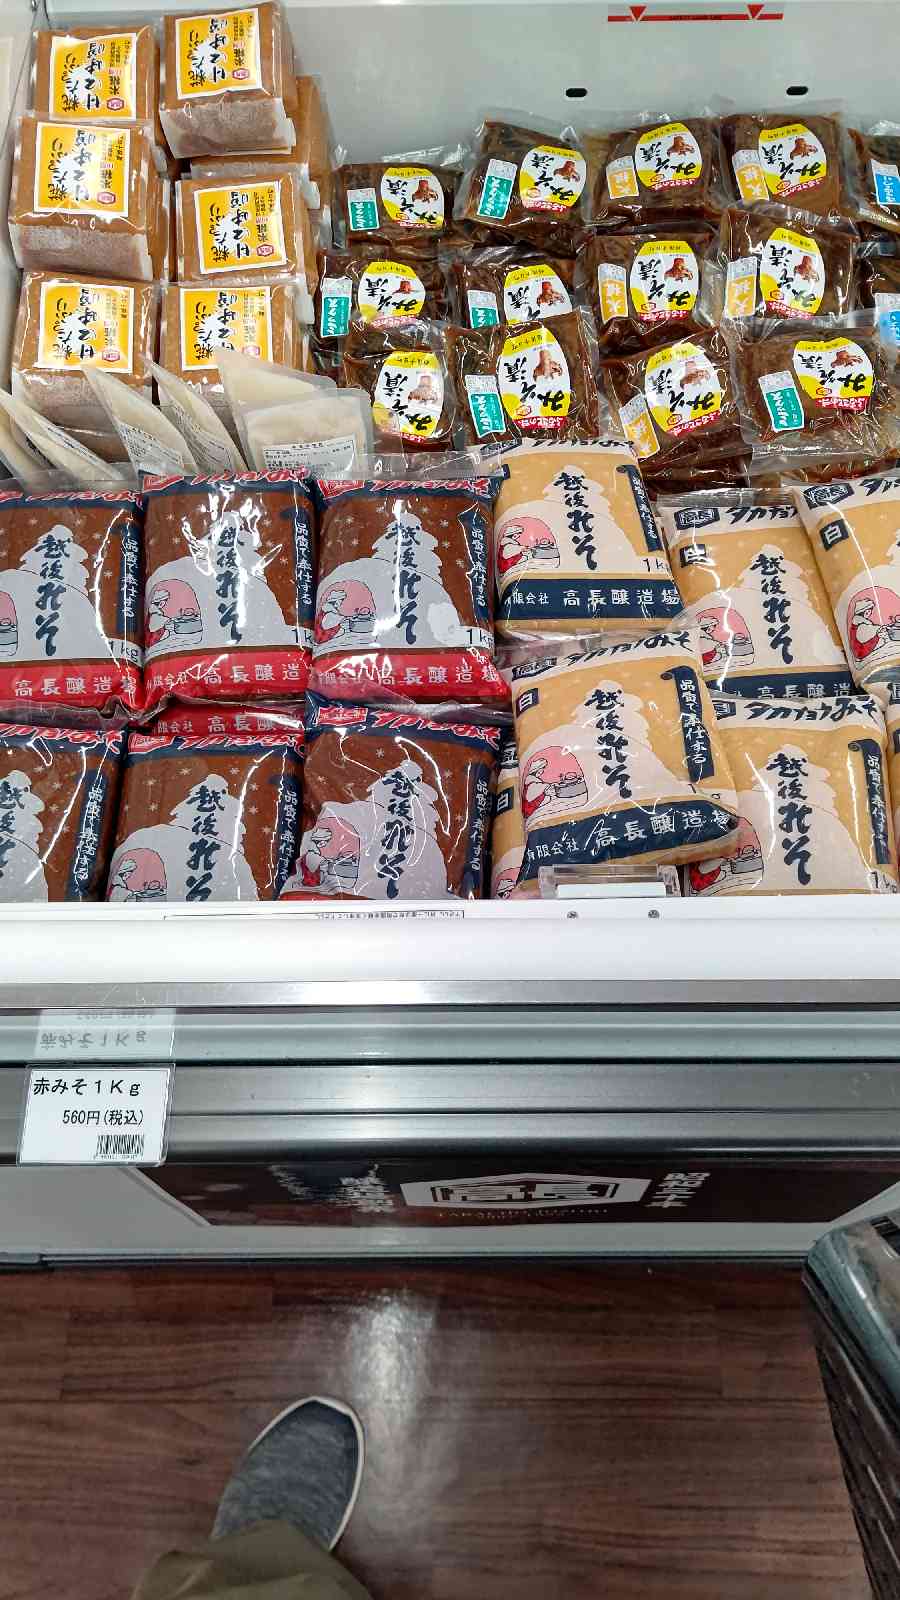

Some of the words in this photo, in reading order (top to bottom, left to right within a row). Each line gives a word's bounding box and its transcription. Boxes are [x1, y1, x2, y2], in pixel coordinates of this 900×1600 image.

[640, 142, 696, 175] みそ漬
[762, 144, 821, 179] みそ漬
[530, 153, 574, 201] みそ漬
[638, 259, 690, 306] みそ漬
[769, 244, 816, 307] みそ漬
[366, 279, 418, 311] みそ漬
[504, 357, 564, 411] みそ漬
[648, 368, 714, 412] みそ漬
[798, 354, 866, 391] みそ漬
[383, 371, 432, 430] みそ漬
[771, 393, 789, 427] ミックス
[824, 527, 843, 544] 白
[518, 693, 534, 712] 白
[679, 679, 708, 765] 品質で奉仕する
[33, 1077, 141, 1096] 赤みそ1Kg
[62, 1110, 144, 1126] 560円(税込)
